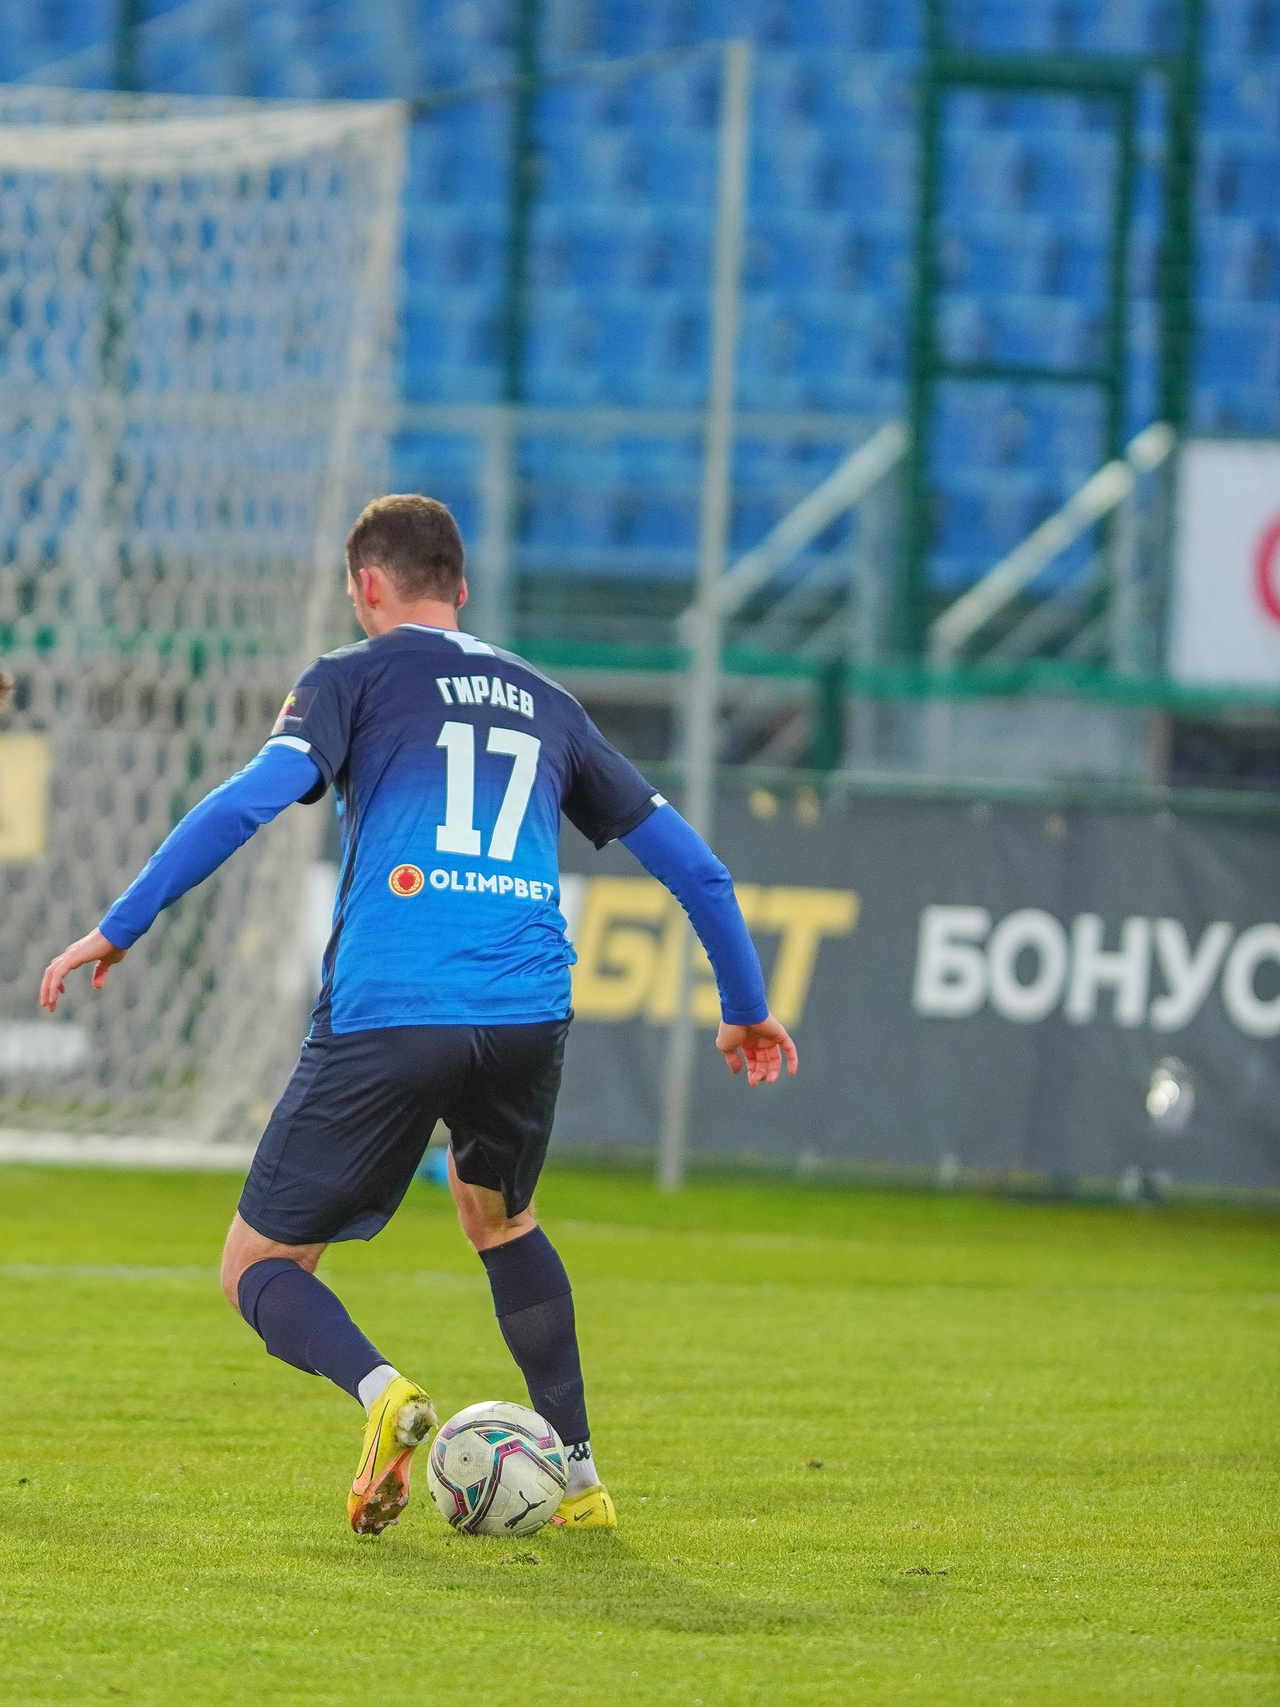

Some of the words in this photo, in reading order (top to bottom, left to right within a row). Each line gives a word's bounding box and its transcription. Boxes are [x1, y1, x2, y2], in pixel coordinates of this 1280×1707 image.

[436, 675, 535, 719] ГИРАЕВ
[435, 720, 542, 862] 17
[429, 868, 555, 902] OLIMPBET
[912, 902, 1280, 1039] БОНУС
